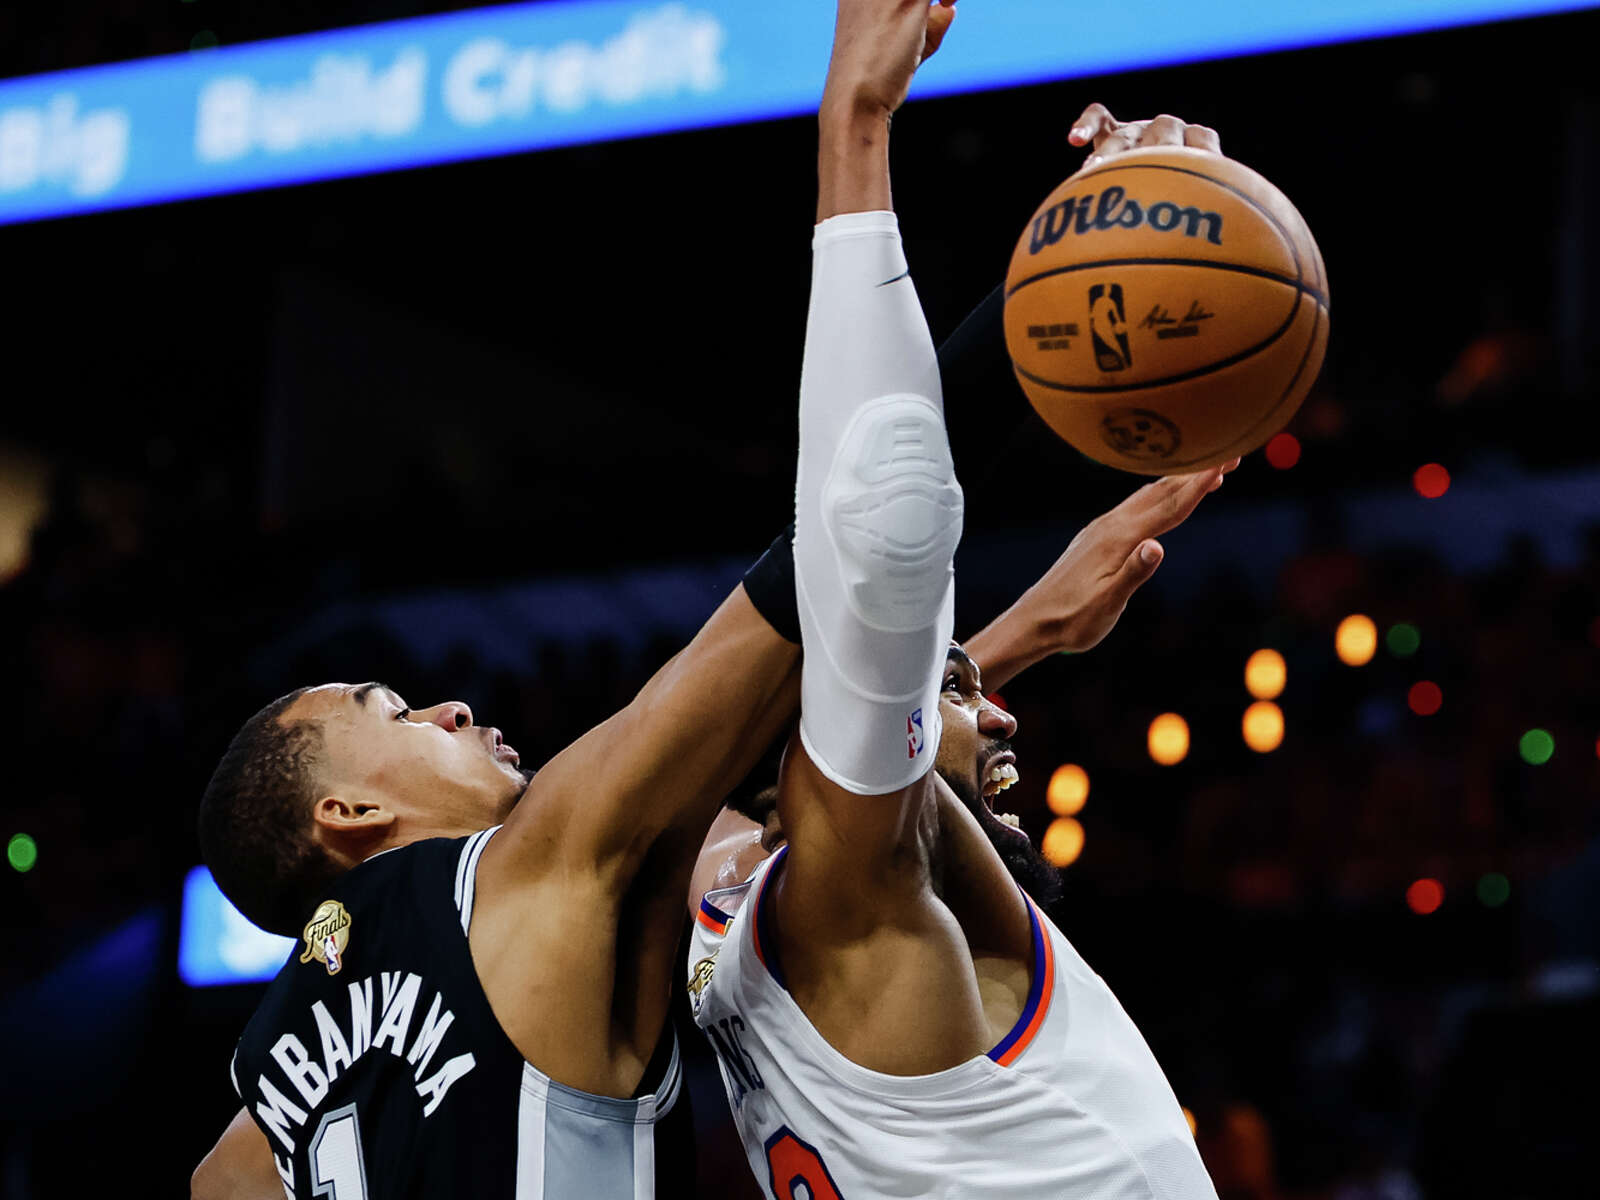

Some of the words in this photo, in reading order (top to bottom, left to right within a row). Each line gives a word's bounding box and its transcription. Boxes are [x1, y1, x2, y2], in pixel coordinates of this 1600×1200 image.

[198, 50, 425, 159] Build
[446, 5, 722, 123] Credit
[1029, 186, 1223, 255] Wilson
[302, 907, 349, 959] Finals
